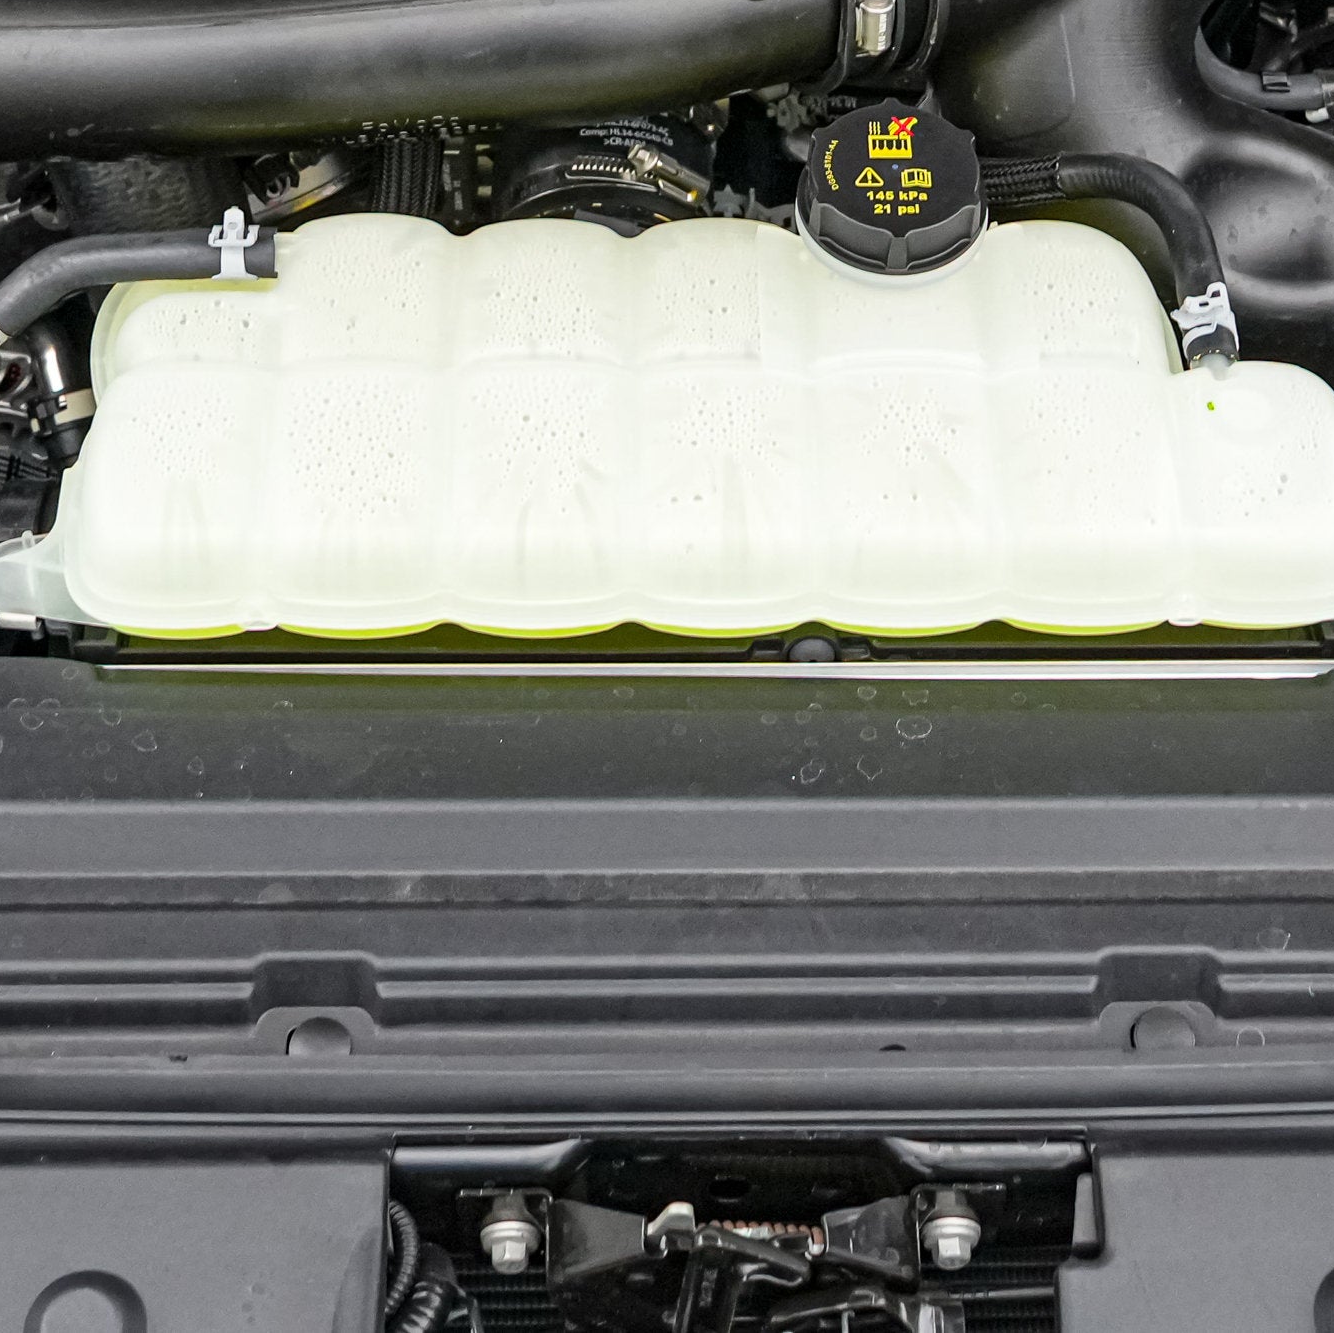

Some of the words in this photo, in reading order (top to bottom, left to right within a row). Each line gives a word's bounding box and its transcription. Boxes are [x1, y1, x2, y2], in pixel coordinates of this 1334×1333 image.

[866, 190, 895, 202] 145
[898, 190, 929, 202] kPa
[873, 203, 892, 215] 21
[897, 203, 920, 216] psi
